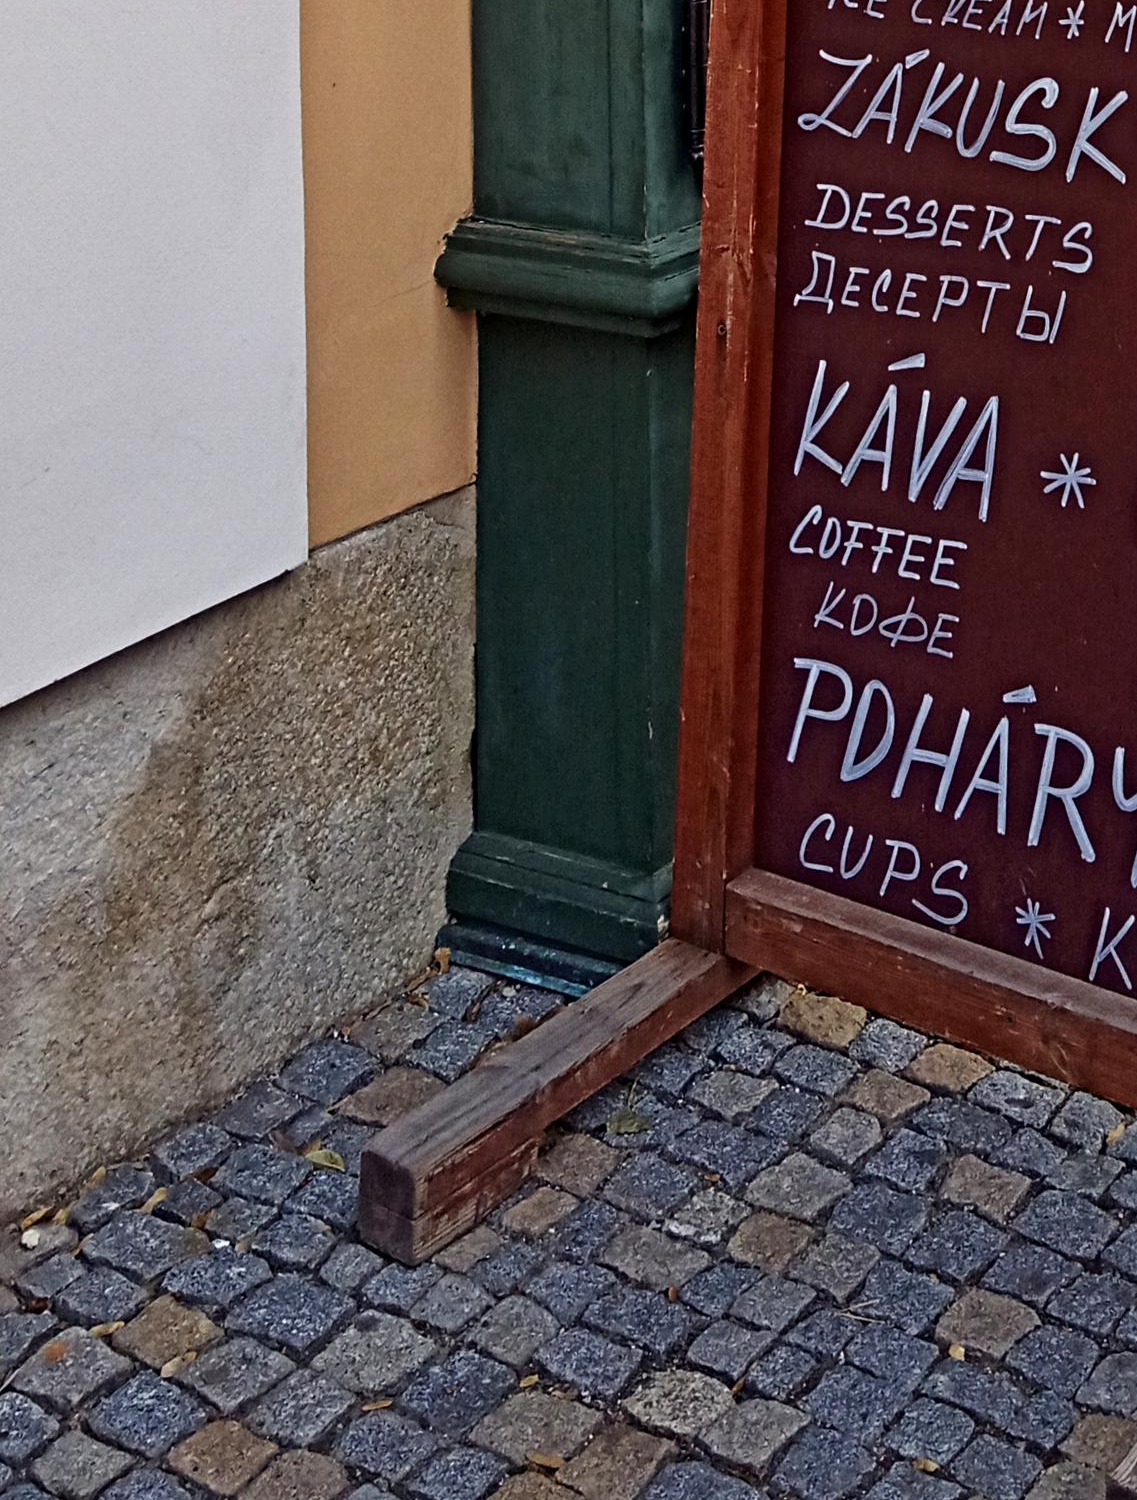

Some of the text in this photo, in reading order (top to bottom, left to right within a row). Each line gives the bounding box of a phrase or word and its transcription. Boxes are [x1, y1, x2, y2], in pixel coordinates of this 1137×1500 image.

[805, 184, 1093, 274] DESSERTS
[794, 251, 1066, 344] ДЕСЕРТЫ
[794, 353, 998, 522] KÁVA
[789, 504, 967, 589] COFFEE
[814, 581, 960, 658] КОФЕ
[799, 813, 969, 925] CUPS
